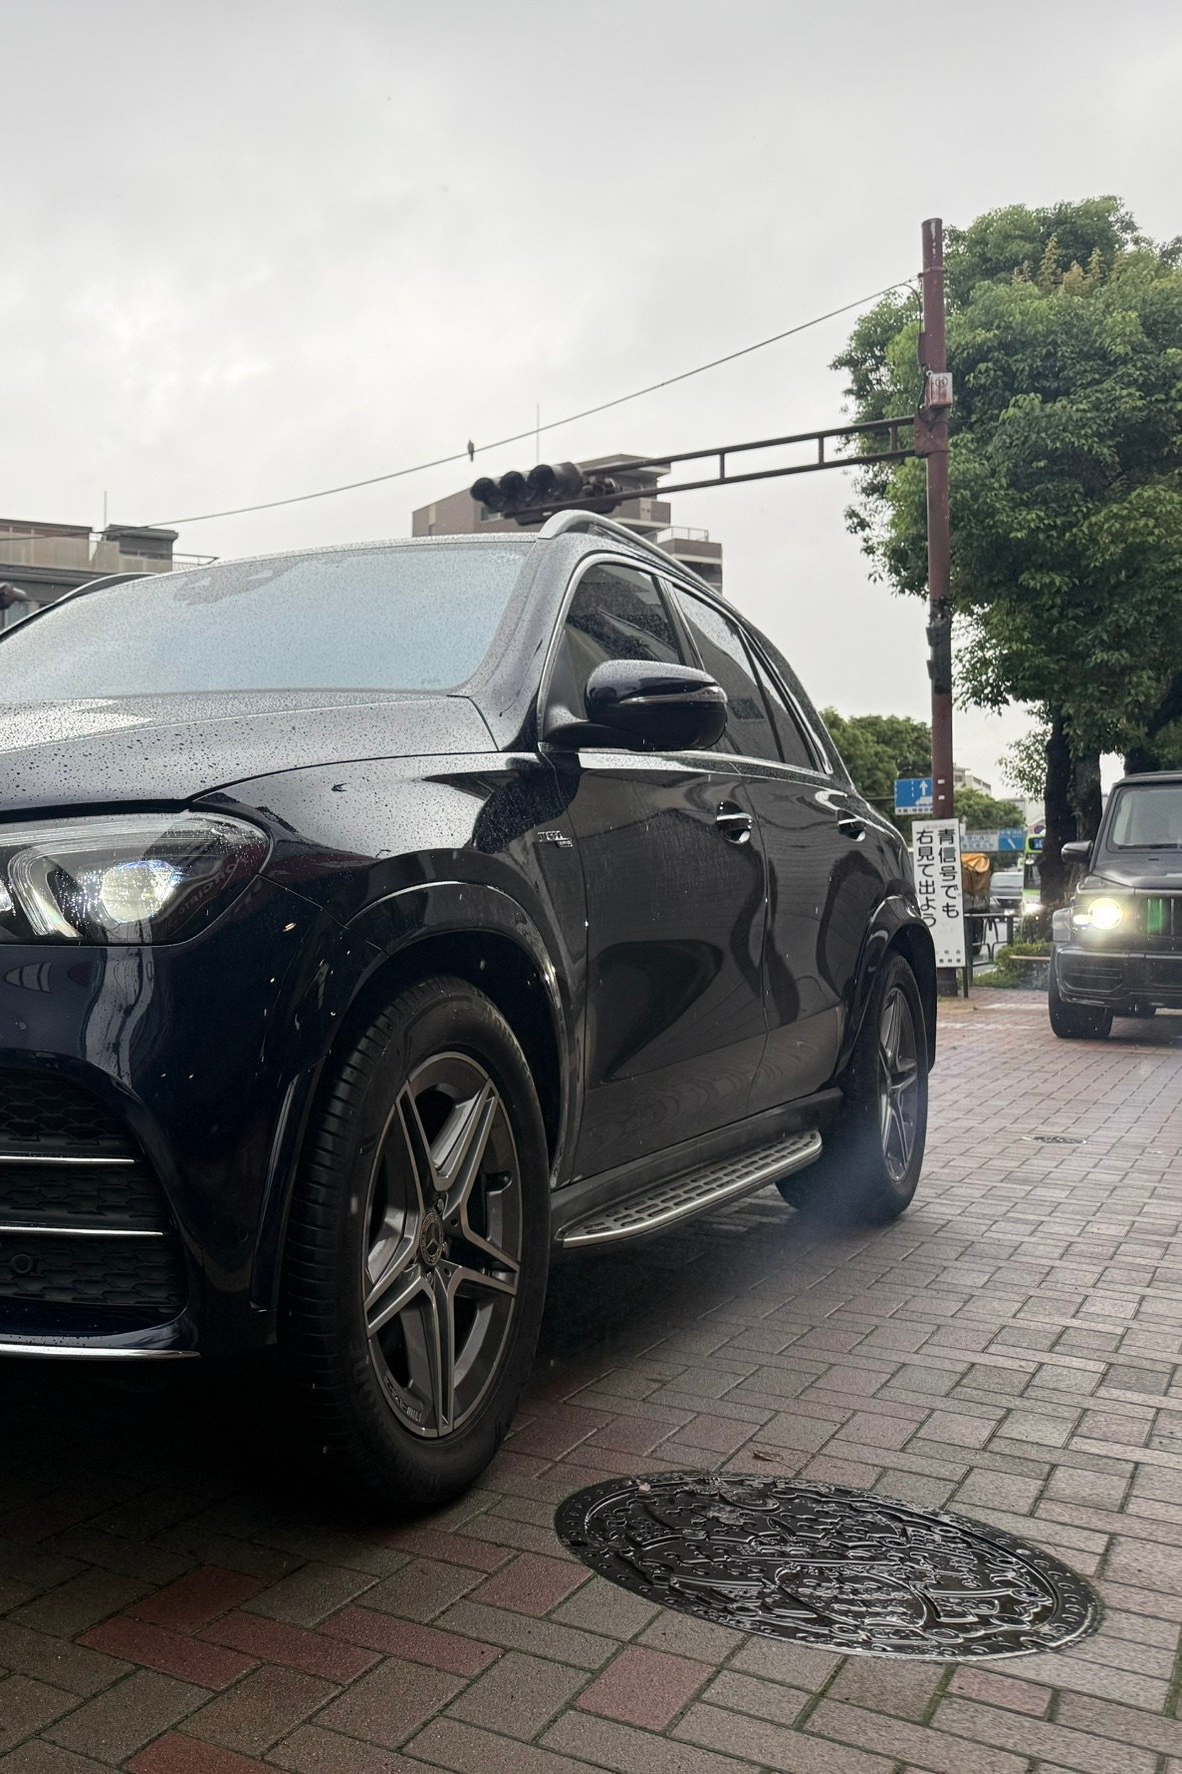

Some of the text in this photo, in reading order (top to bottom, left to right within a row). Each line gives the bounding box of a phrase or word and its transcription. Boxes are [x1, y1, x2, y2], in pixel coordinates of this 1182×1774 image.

[916, 829, 937, 928] 右見て出よう
[938, 828, 960, 919] 青信号でも
